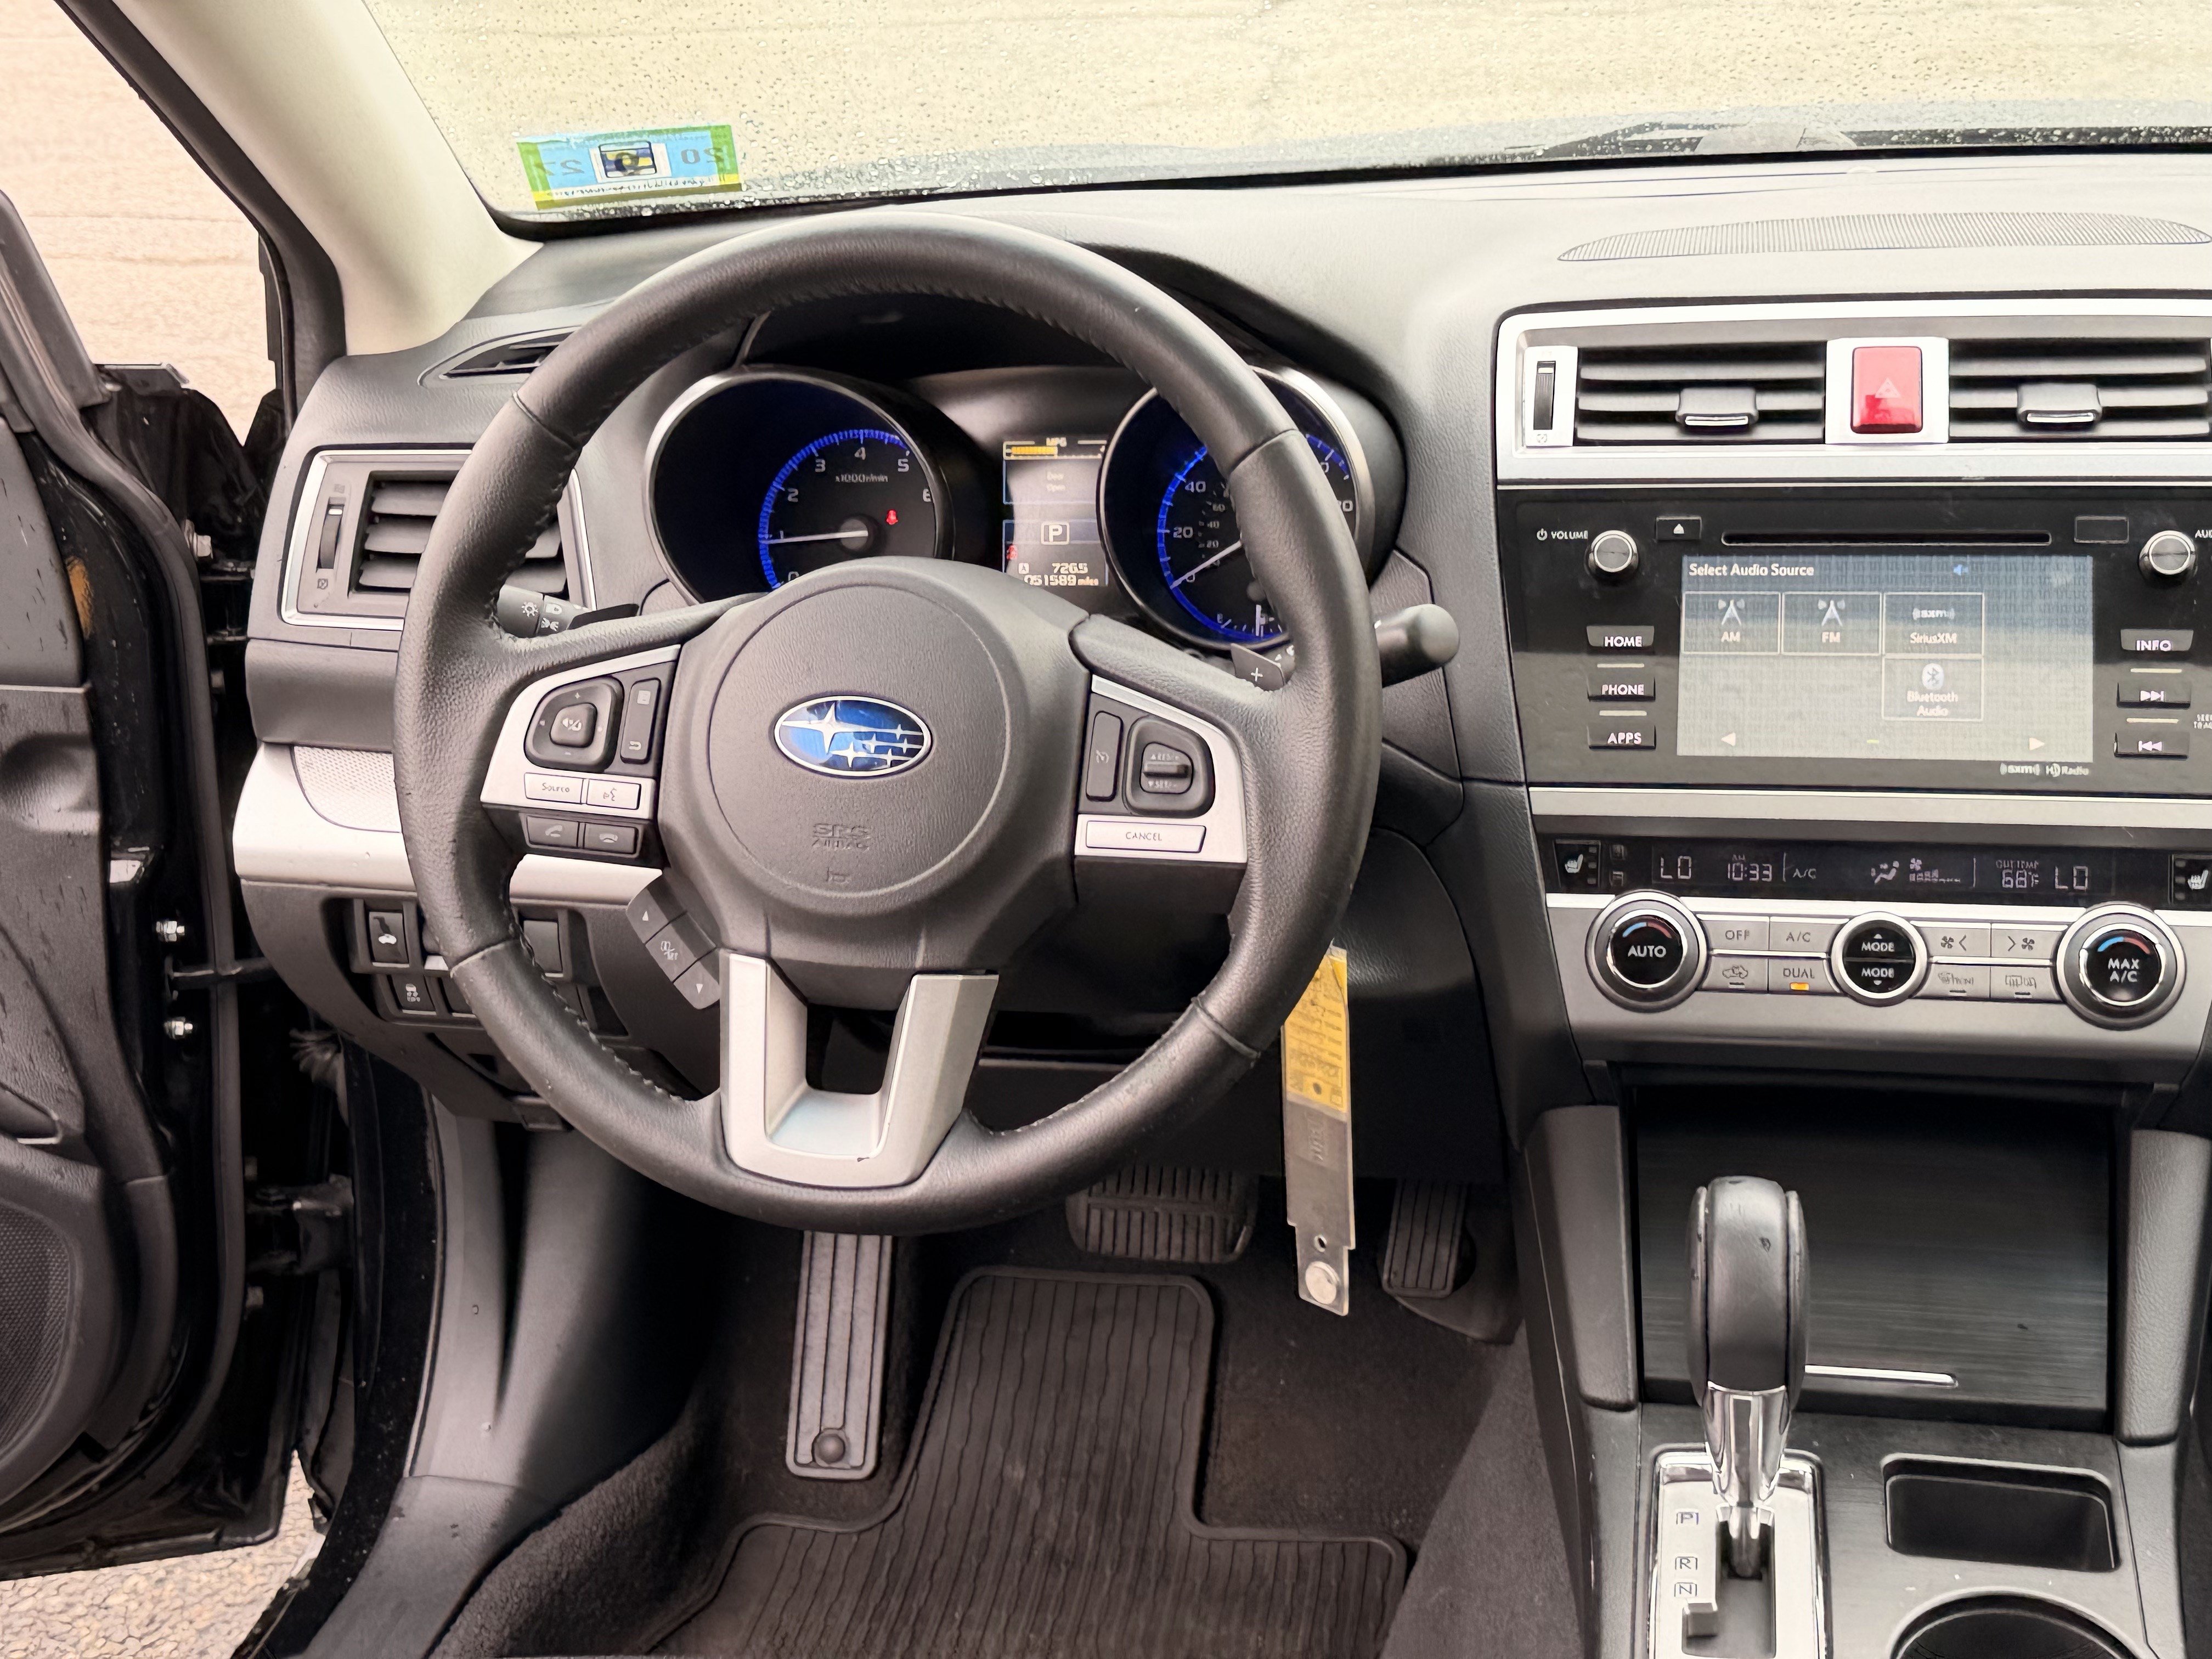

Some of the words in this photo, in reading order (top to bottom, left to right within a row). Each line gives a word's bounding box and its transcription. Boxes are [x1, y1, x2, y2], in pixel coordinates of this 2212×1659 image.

[854, 447, 867, 460] 4
[815, 459, 826, 472] 3
[897, 458, 910, 472] 5
[1184, 481, 1206, 494] 40
[787, 488, 799, 503] 2
[1048, 524, 1063, 543] P
[1173, 526, 1194, 539] 20
[1550, 530, 1589, 540] VOLUME
[1689, 562, 1728, 577] Select
[1729, 562, 1769, 577] Audio
[1770, 562, 1815, 577] Source
[1604, 635, 1643, 647] HOME
[1720, 631, 1741, 643] AM
[1821, 631, 1841, 644] FM
[2136, 639, 2172, 652] INFO
[1601, 684, 1645, 696] PHONE
[1906, 690, 1959, 703] Bluetooth
[1916, 705, 1949, 717] Audio
[1607, 731, 1643, 745] APPS
[1125, 831, 1163, 842] CANCEL
[1659, 855, 1692, 880] LO
[1727, 862, 1773, 882] 10:33
[2054, 865, 2089, 891] LO
[1725, 929, 1751, 941] OFF
[1786, 930, 1812, 943] A/C
[1627, 945, 1667, 958] AUTO
[1861, 941, 1895, 953] MODE
[2108, 957, 2140, 970] MAX
[1782, 967, 1816, 979] DUAL
[1861, 967, 1895, 978] MODE
[2109, 972, 2140, 983] A/C
[1680, 1512, 1694, 1524] P
[1679, 1558, 1691, 1570] R
[1679, 1583, 1692, 1595] N
